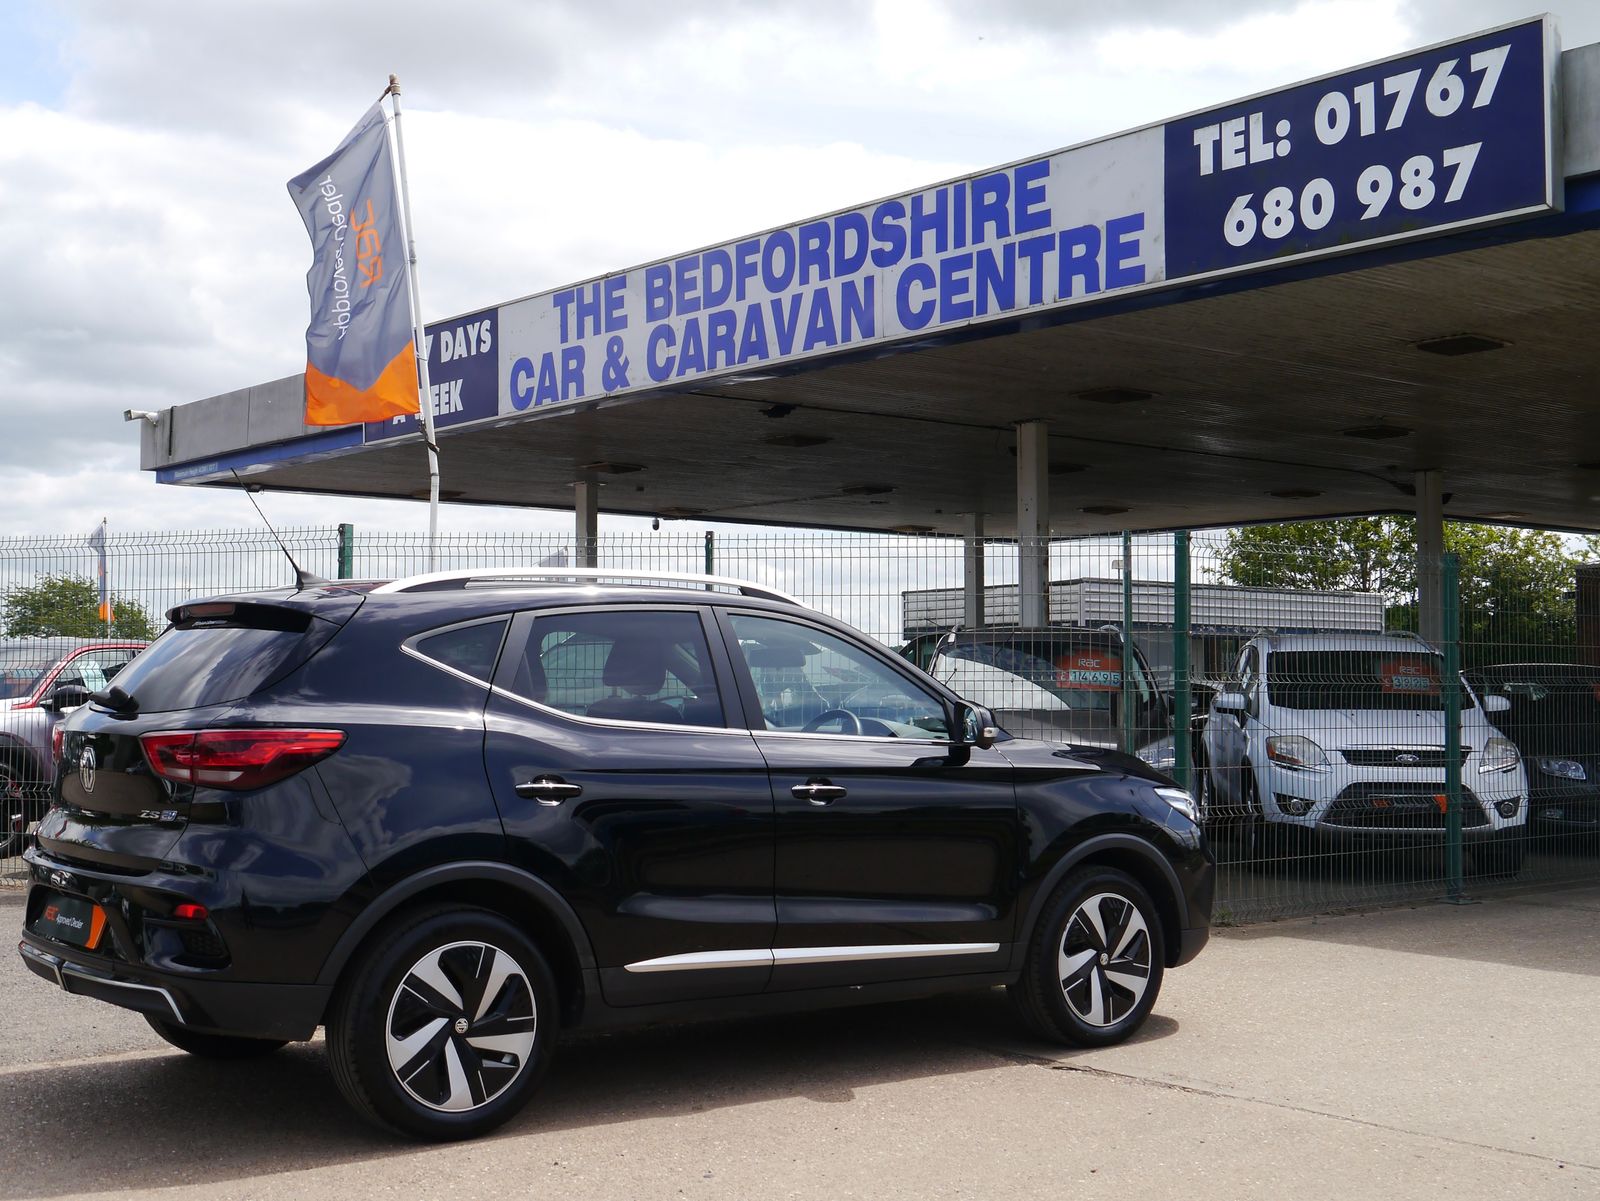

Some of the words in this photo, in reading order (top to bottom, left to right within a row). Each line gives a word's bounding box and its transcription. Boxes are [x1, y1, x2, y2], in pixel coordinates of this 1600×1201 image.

[1193, 111, 1292, 177] TEL:
[1314, 43, 1512, 146] 01767
[552, 274, 629, 345] THE
[644, 158, 1052, 324] BEDFORDSHIRE
[1223, 177, 1335, 247] 680
[1356, 140, 1483, 221] 987
[440, 319, 492, 363] DAYS
[509, 345, 586, 412] CAR
[601, 335, 631, 393] &
[646, 274, 876, 383] CARAVAN
[896, 211, 1146, 331] CENTRE
